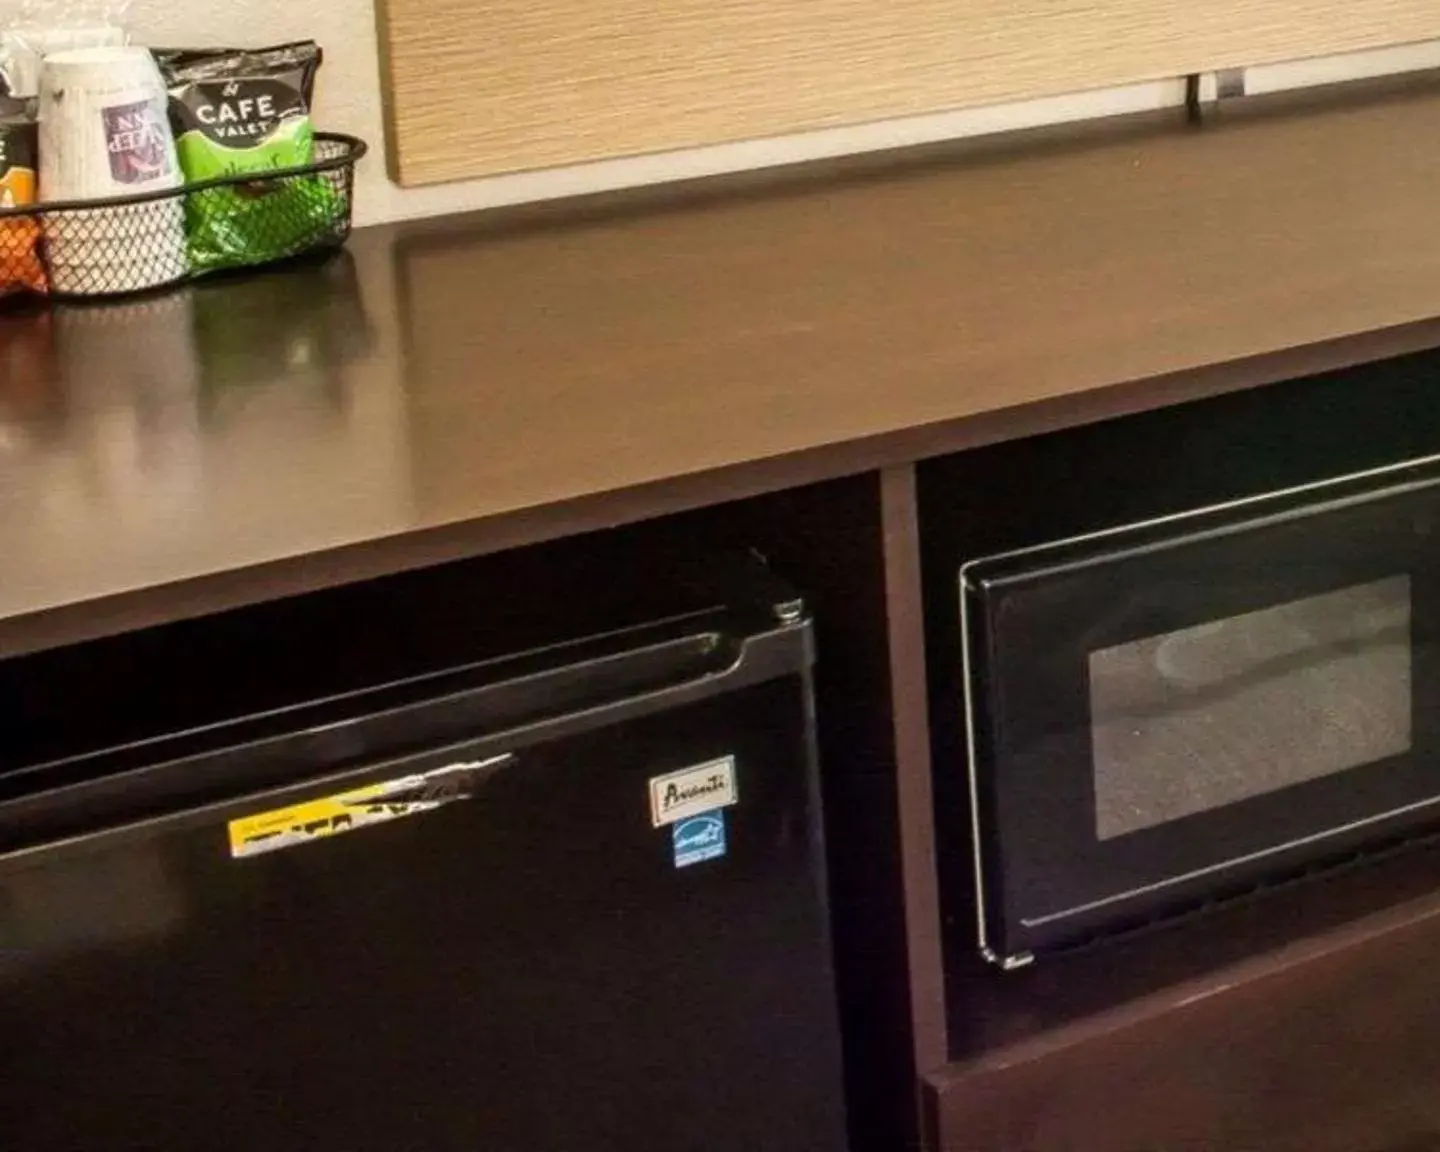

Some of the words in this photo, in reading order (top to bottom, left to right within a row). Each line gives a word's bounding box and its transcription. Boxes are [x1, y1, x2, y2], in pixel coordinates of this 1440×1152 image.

[196, 95, 277, 124] CAFE
[214, 121, 271, 139] VALET
[663, 774, 725, 809] Avanti
